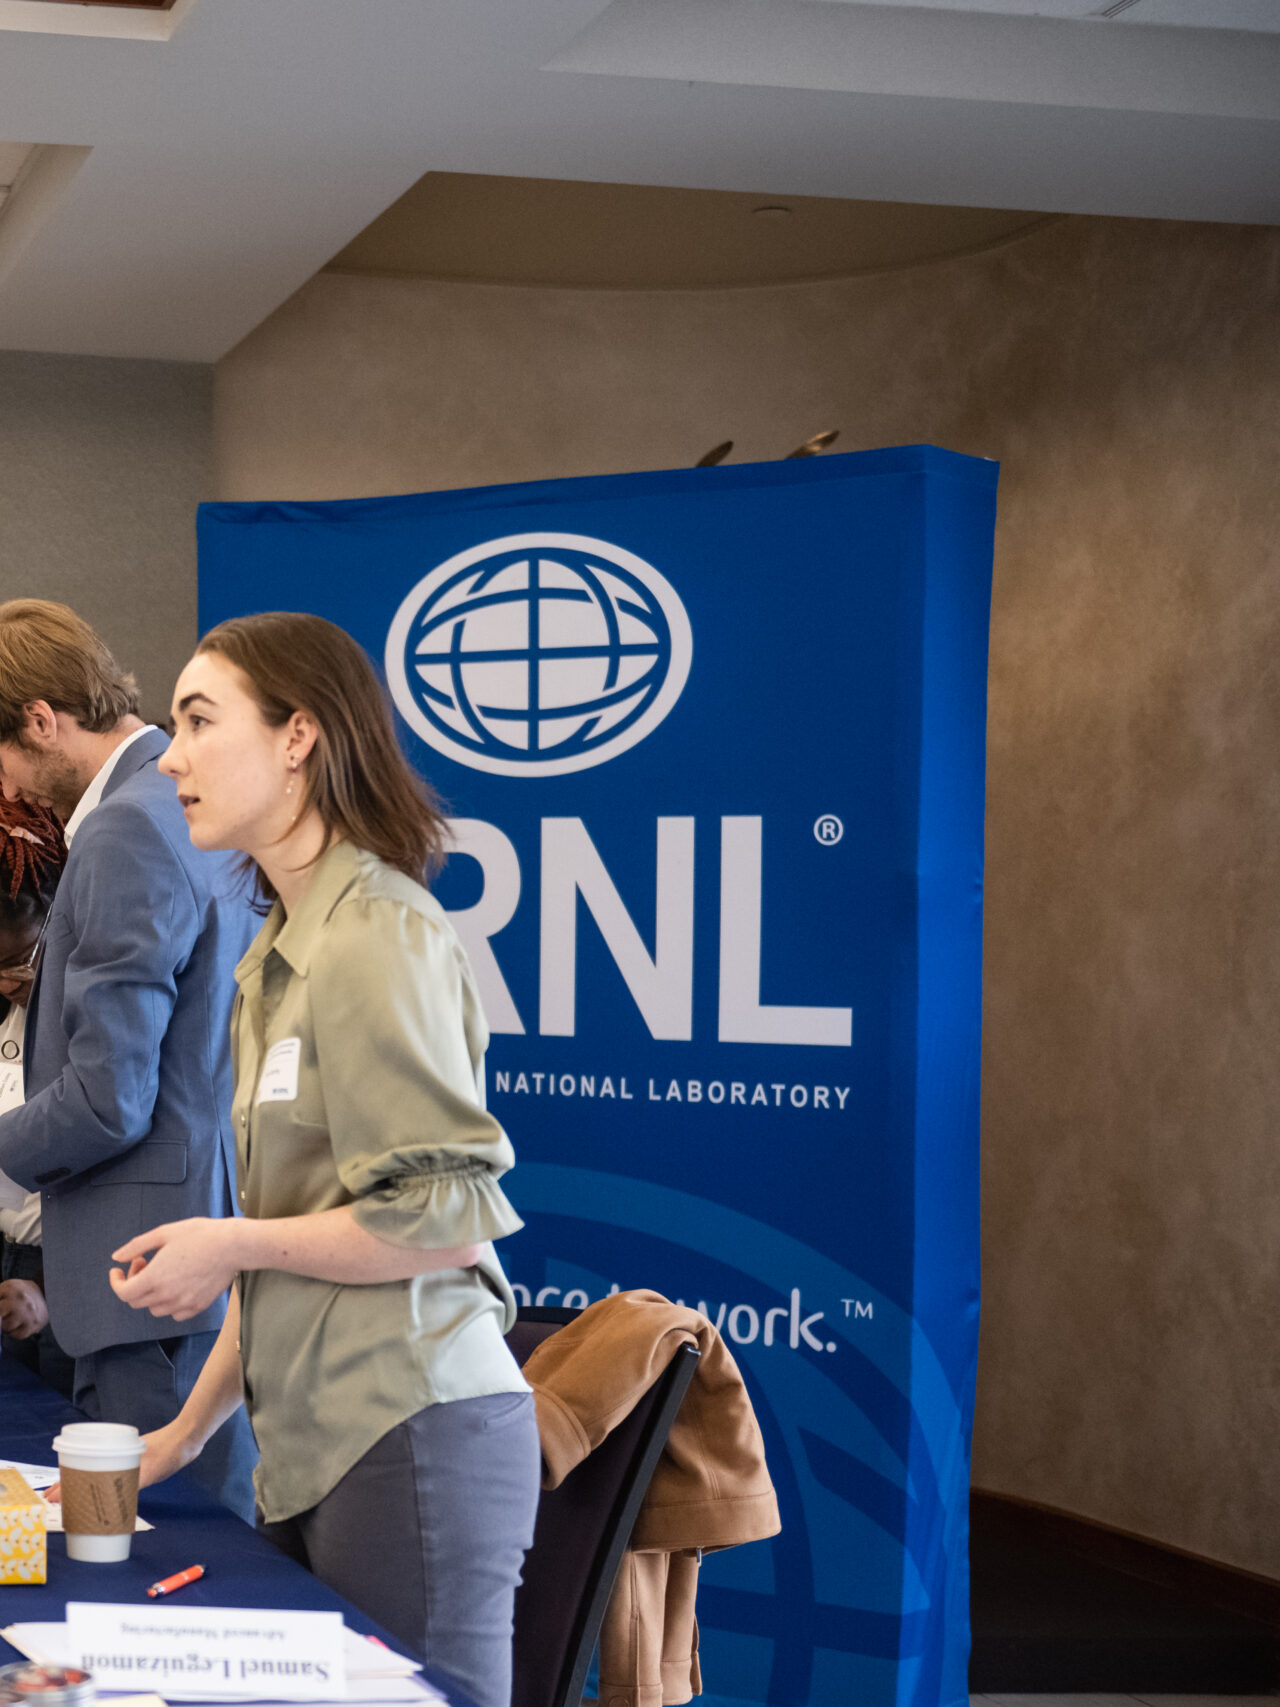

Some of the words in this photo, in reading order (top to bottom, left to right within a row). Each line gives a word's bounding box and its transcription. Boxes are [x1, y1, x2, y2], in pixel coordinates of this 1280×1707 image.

[440, 815, 852, 1047] RNL
[495, 1071, 634, 1100] NATIONAL
[648, 1079, 851, 1110] LABORATORY
[240, 1657, 330, 1681] Samuel
